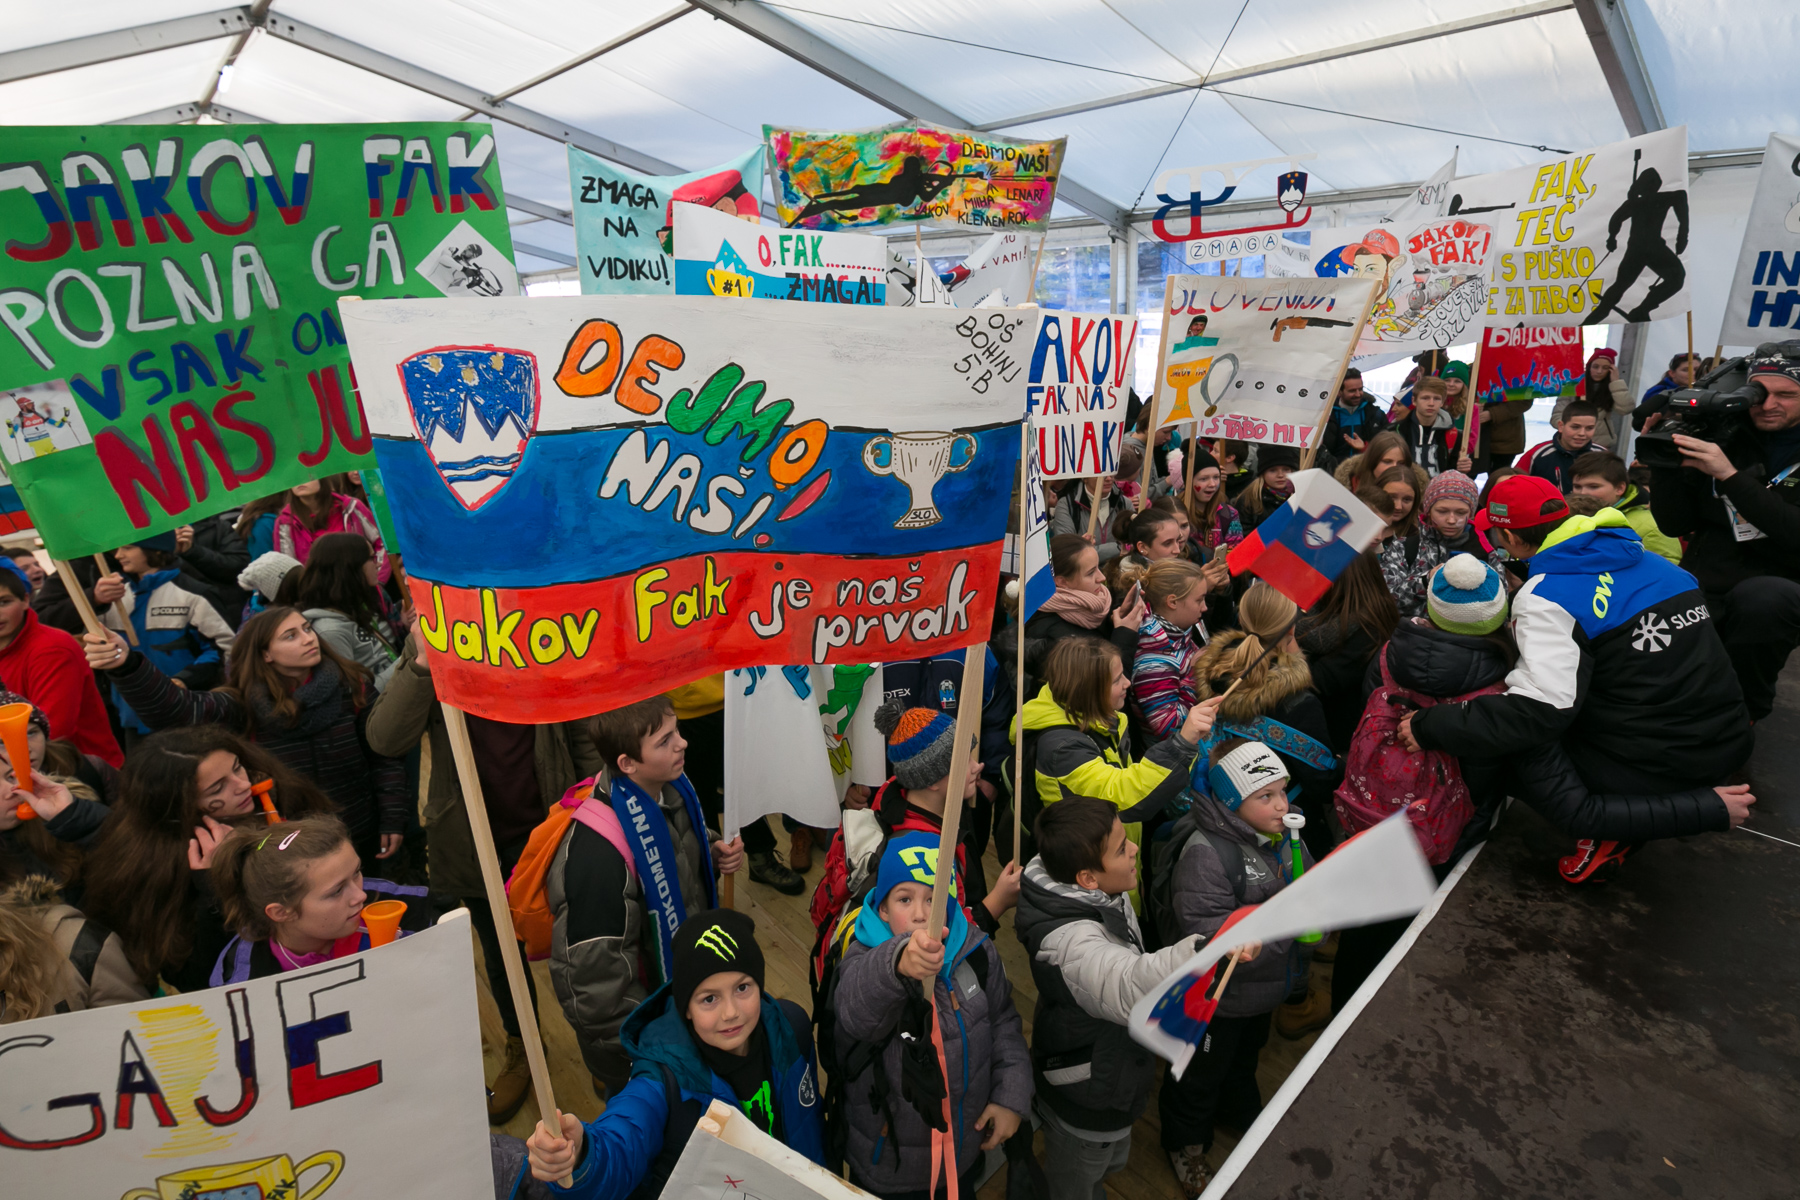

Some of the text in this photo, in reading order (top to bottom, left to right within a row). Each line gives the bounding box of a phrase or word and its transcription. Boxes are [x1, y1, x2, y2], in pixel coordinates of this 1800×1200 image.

[962, 142, 1049, 173] DEJMO NAŠI
[580, 176, 659, 210] ZMAGA
[1006, 188, 1045, 202] LENART
[1528, 154, 1597, 204] FAK,
[0, 134, 501, 262] JAKOV FAK
[914, 203, 949, 218] JAKOV
[604, 216, 639, 238] NA
[957, 211, 1030, 227] KLEMEN ROK
[992, 245, 1027, 266] VAMI!
[1192, 234, 1277, 259] ZMAGA
[1408, 221, 1479, 254] JAKOV
[1429, 231, 1492, 266] FAK!
[311, 222, 406, 292] GA
[587, 254, 671, 286] VIDIKU!
[1501, 245, 1596, 283] S PUŠKO
[0, 242, 281, 371] POZNA
[722, 279, 743, 298] #1
[1170, 276, 1340, 316] SLOVENIJA
[1504, 287, 1527, 315] ZA
[1529, 278, 1605, 315] TABO!
[956, 316, 1022, 383] BOHINJ
[1028, 315, 1138, 388] AKOV
[553, 317, 830, 491] DEJMO
[1026, 382, 1118, 416] FAK, NAŠ
[1223, 419, 1268, 440] TABO
[93, 381, 277, 529] NAŠ
[1034, 421, 1125, 476] UNAK!
[910, 510, 932, 520] SLO
[419, 555, 924, 669] Jakov Fak je naš
[812, 560, 977, 665] prvak
[0, 958, 383, 1151] GAJE
